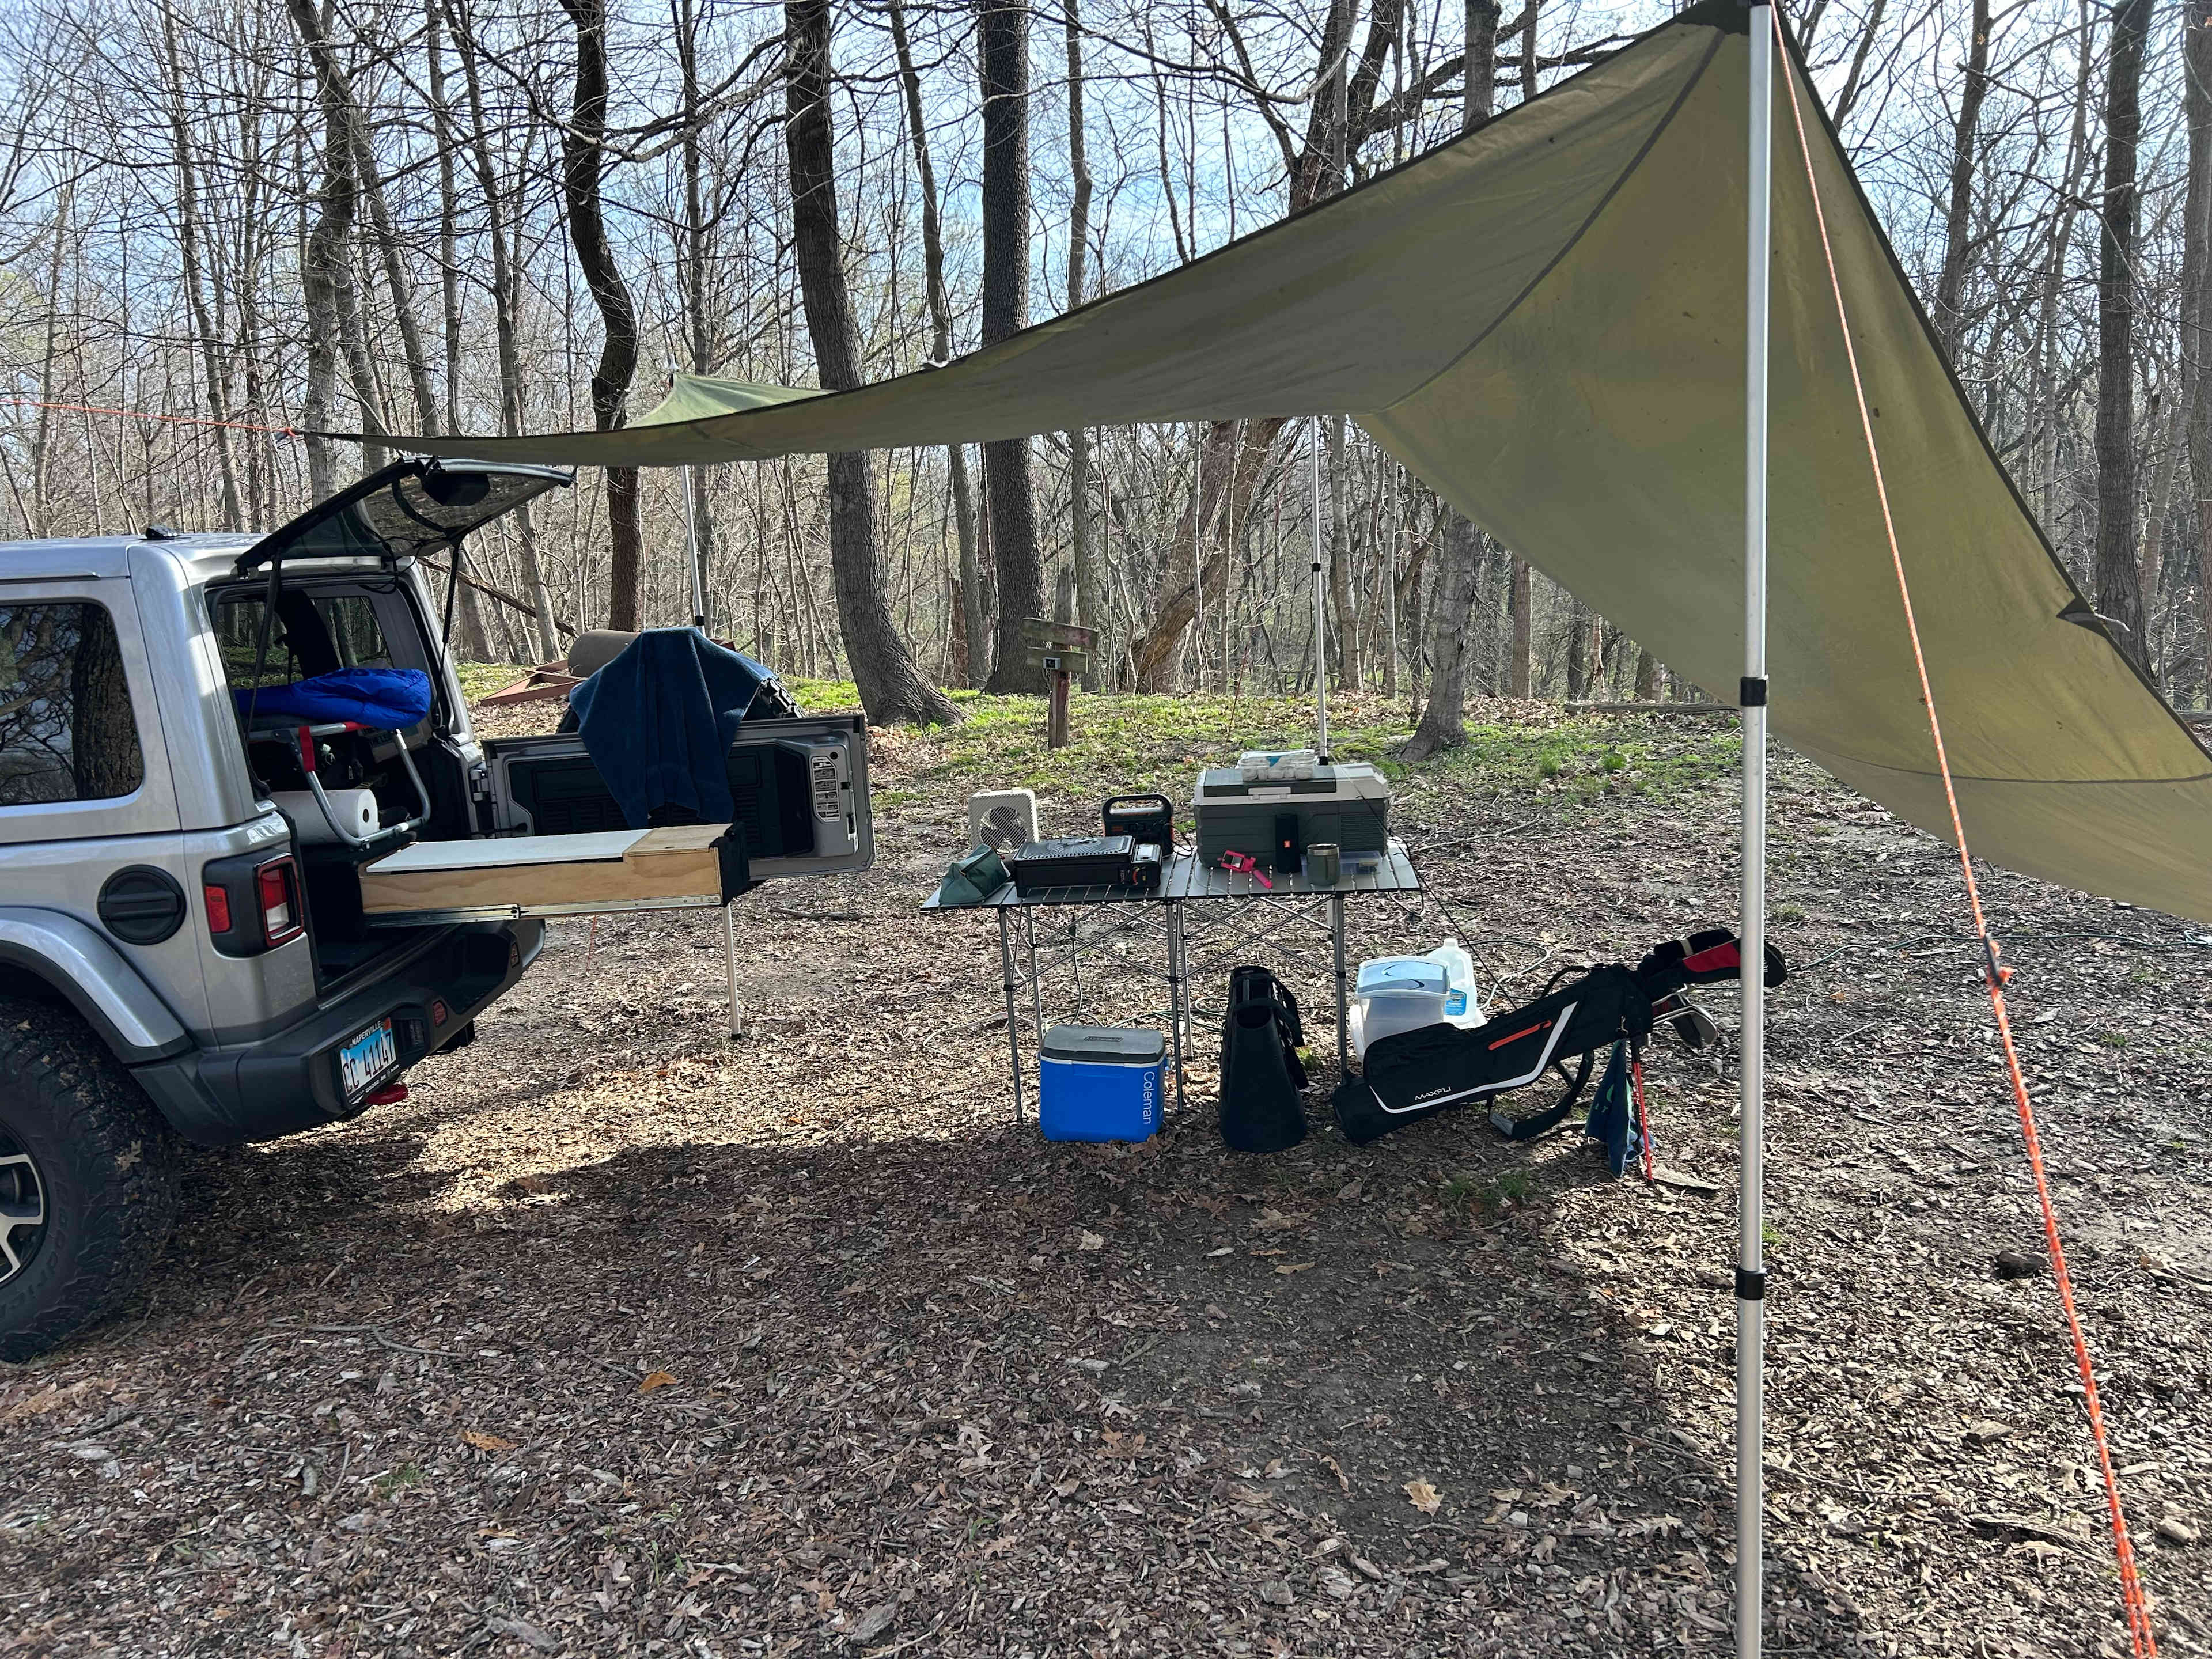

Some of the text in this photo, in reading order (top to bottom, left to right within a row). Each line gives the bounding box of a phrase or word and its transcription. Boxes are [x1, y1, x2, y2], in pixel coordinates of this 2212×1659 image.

[351, 1020, 382, 1045] NAPERVILLE
[362, 1031, 395, 1078] 41147
[1142, 1071, 1155, 1124] Coleman
[1415, 1086, 1452, 1101] MAXFLI
